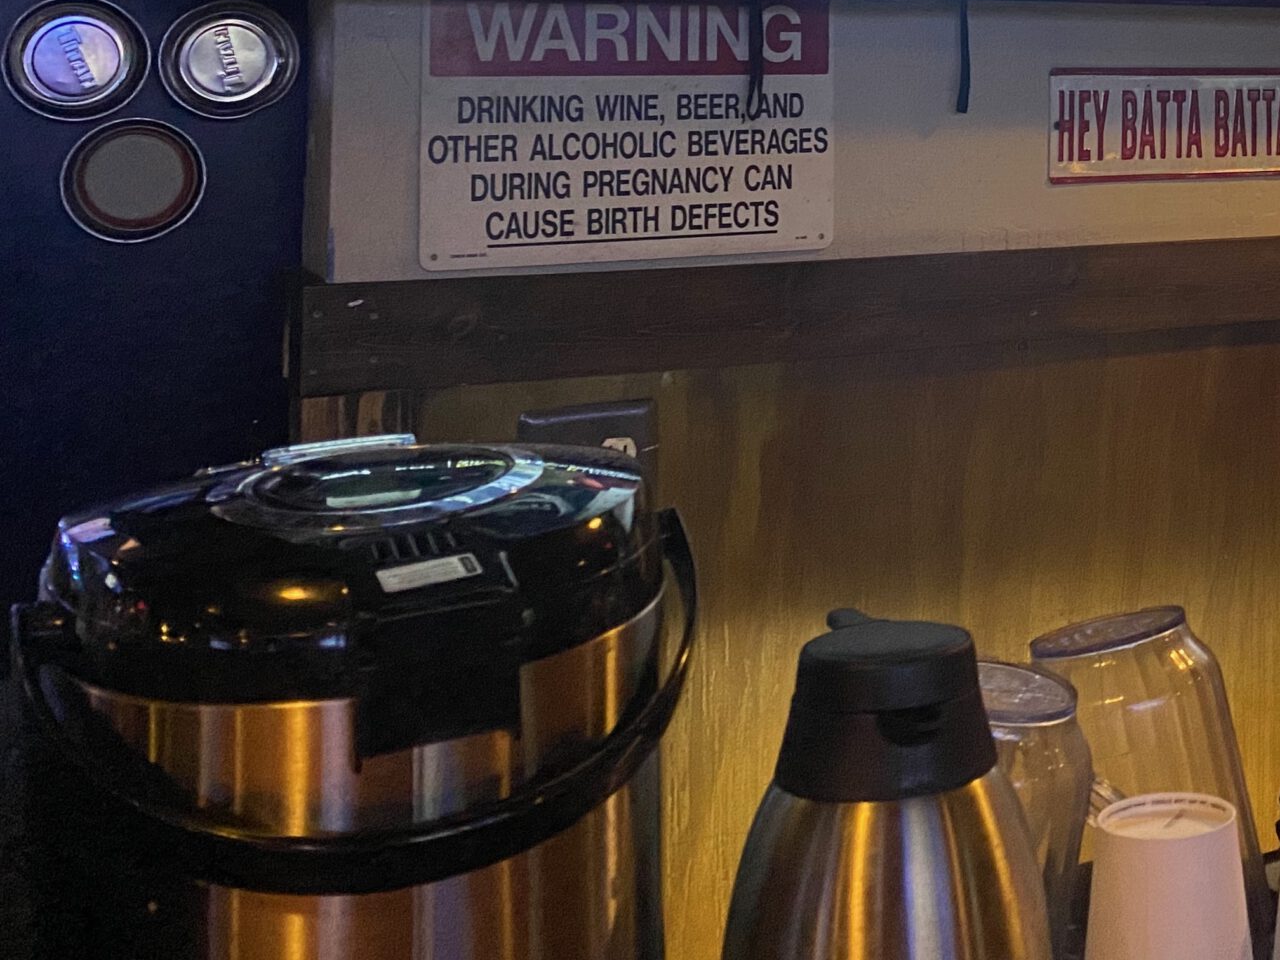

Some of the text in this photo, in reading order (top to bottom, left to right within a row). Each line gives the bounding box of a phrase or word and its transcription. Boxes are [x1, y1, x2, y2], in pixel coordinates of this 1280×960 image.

[468, 3, 801, 62] WARNING
[457, 92, 804, 126] DRINKING WINE, BEER, AND
[1057, 90, 1110, 162] HEY
[1121, 90, 1202, 160] BATTA
[428, 127, 828, 164] OTHER ALCOHOLIC BEVERAGES
[471, 164, 792, 202] DURING PREGNANCY CAN
[485, 200, 779, 240] CAUSE BIRTH DEFECTS
